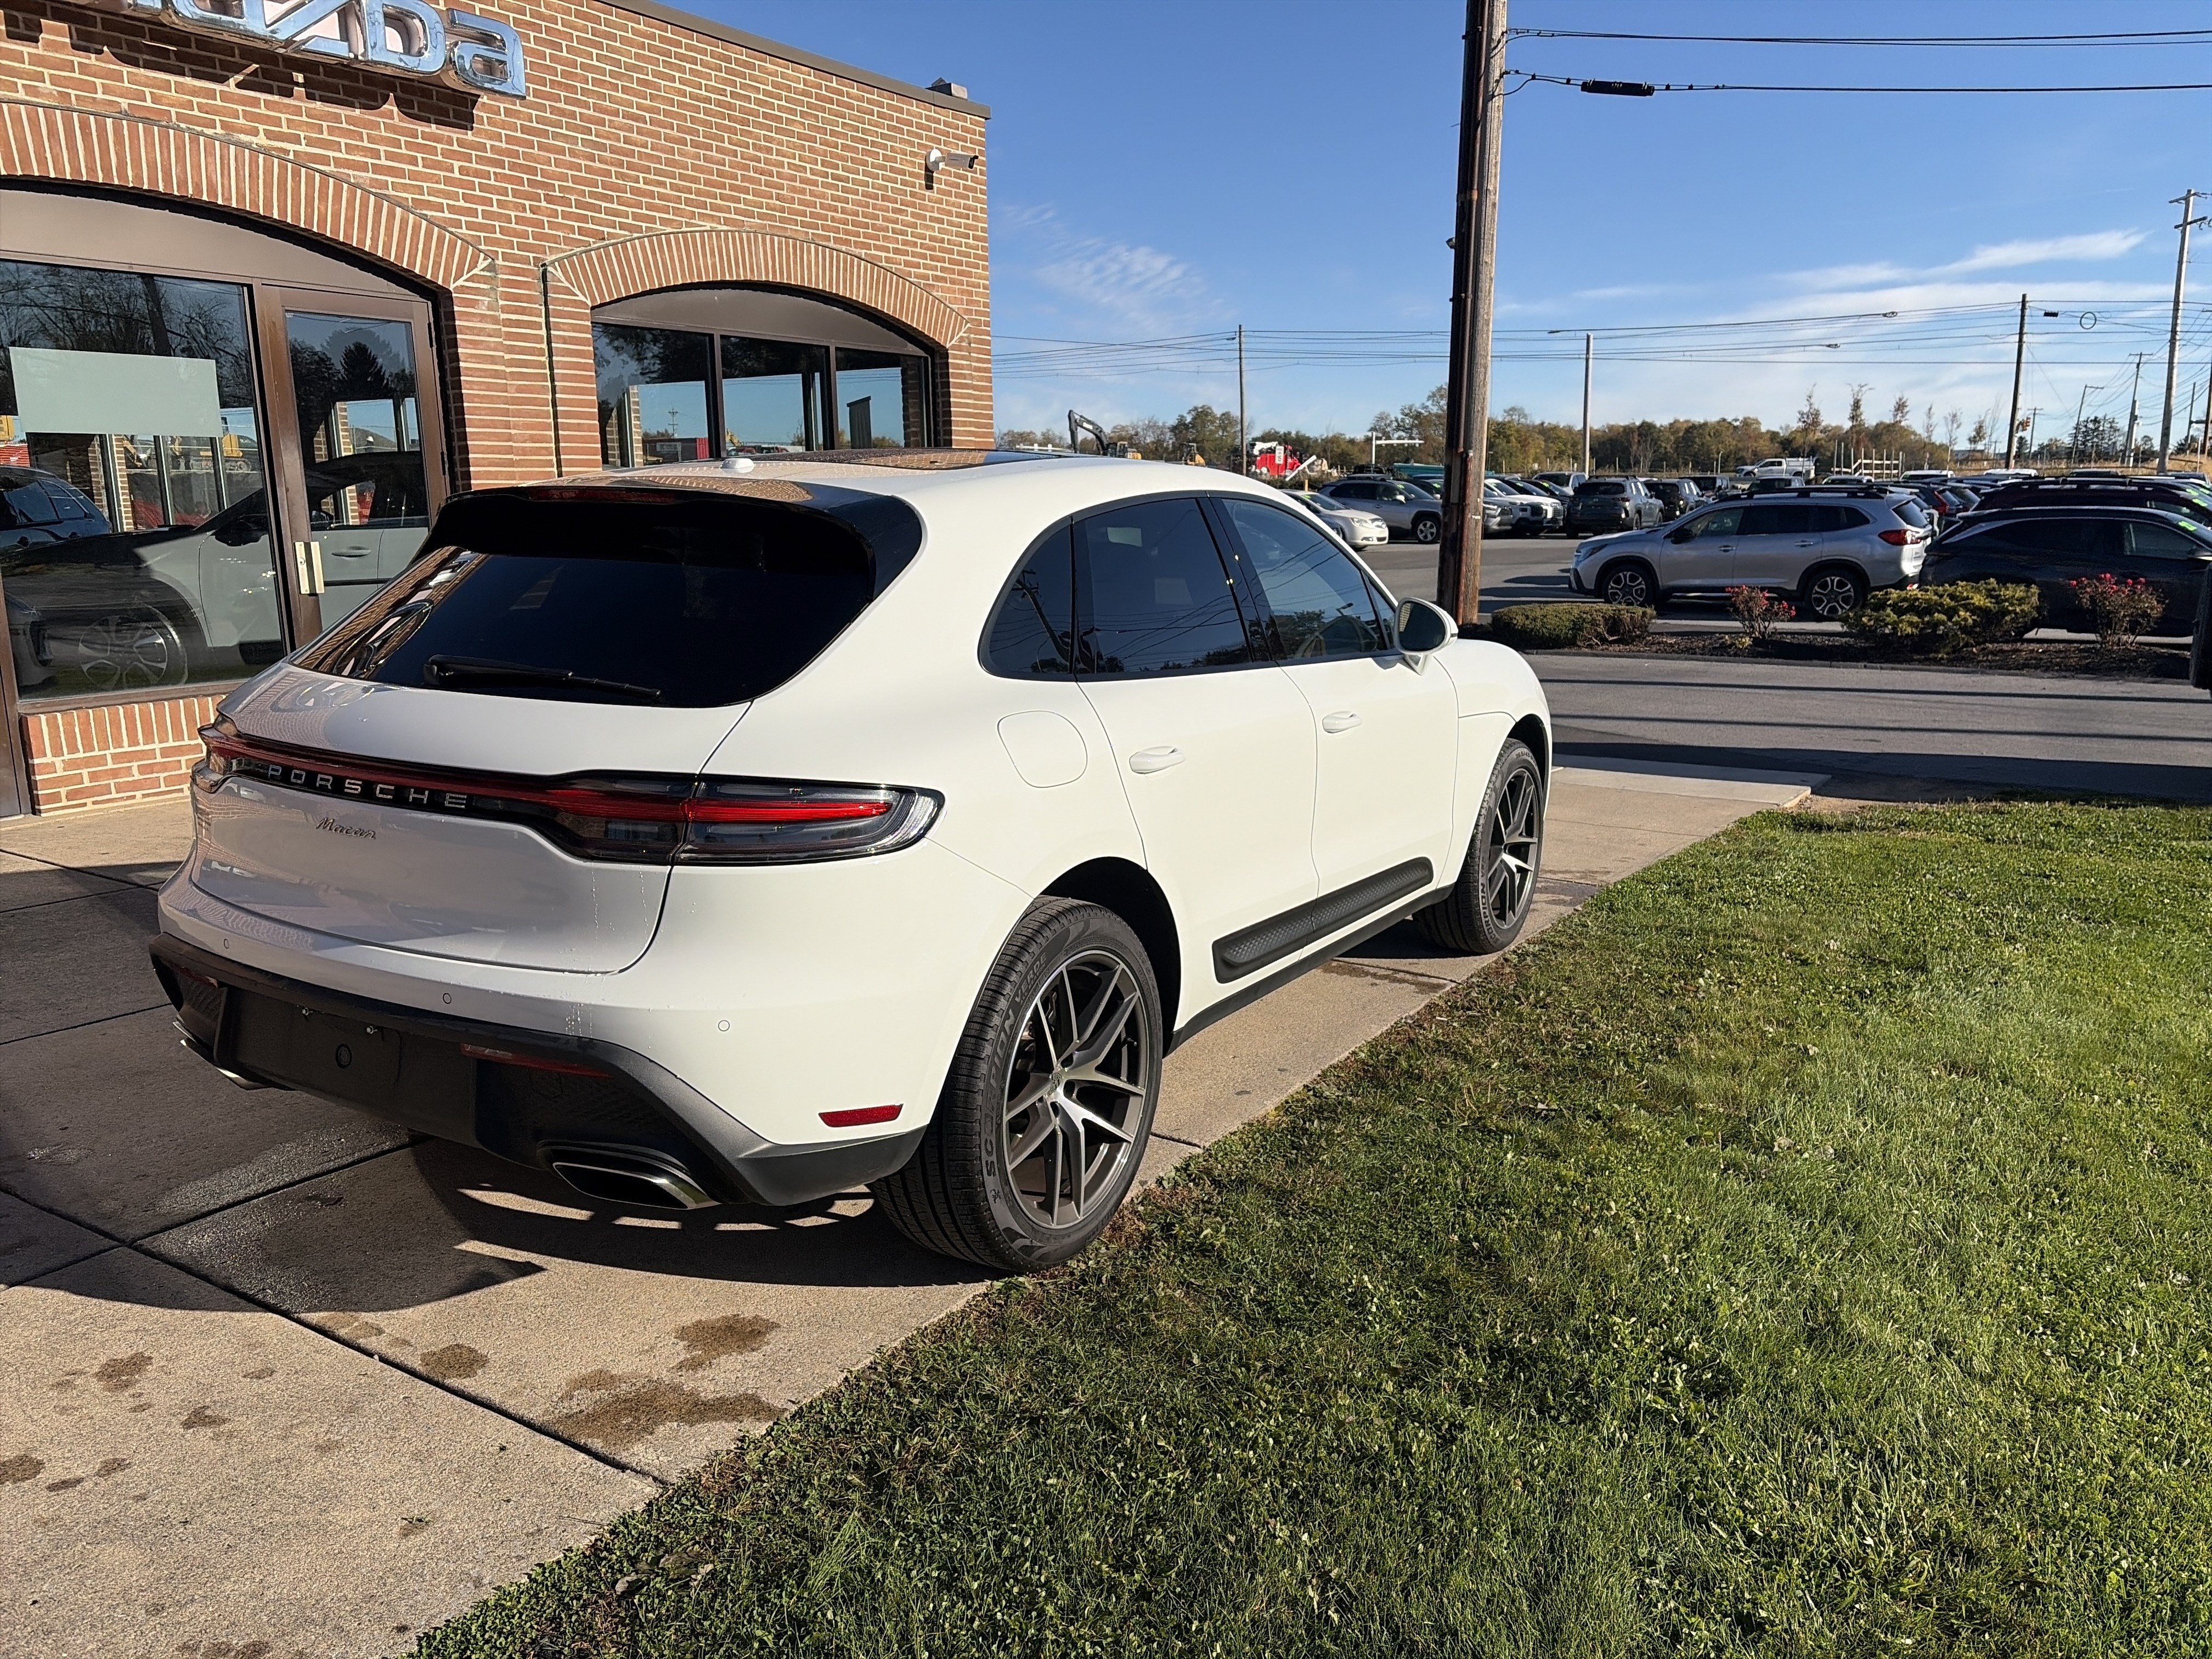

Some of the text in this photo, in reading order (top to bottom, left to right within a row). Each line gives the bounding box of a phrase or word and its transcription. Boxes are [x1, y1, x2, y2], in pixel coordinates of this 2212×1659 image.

[268, 764, 467, 809] PORSCHE
[314, 817, 377, 840] Macan
[984, 1007, 1015, 1178] SCORPION
[1015, 952, 1047, 1003] VERDE
